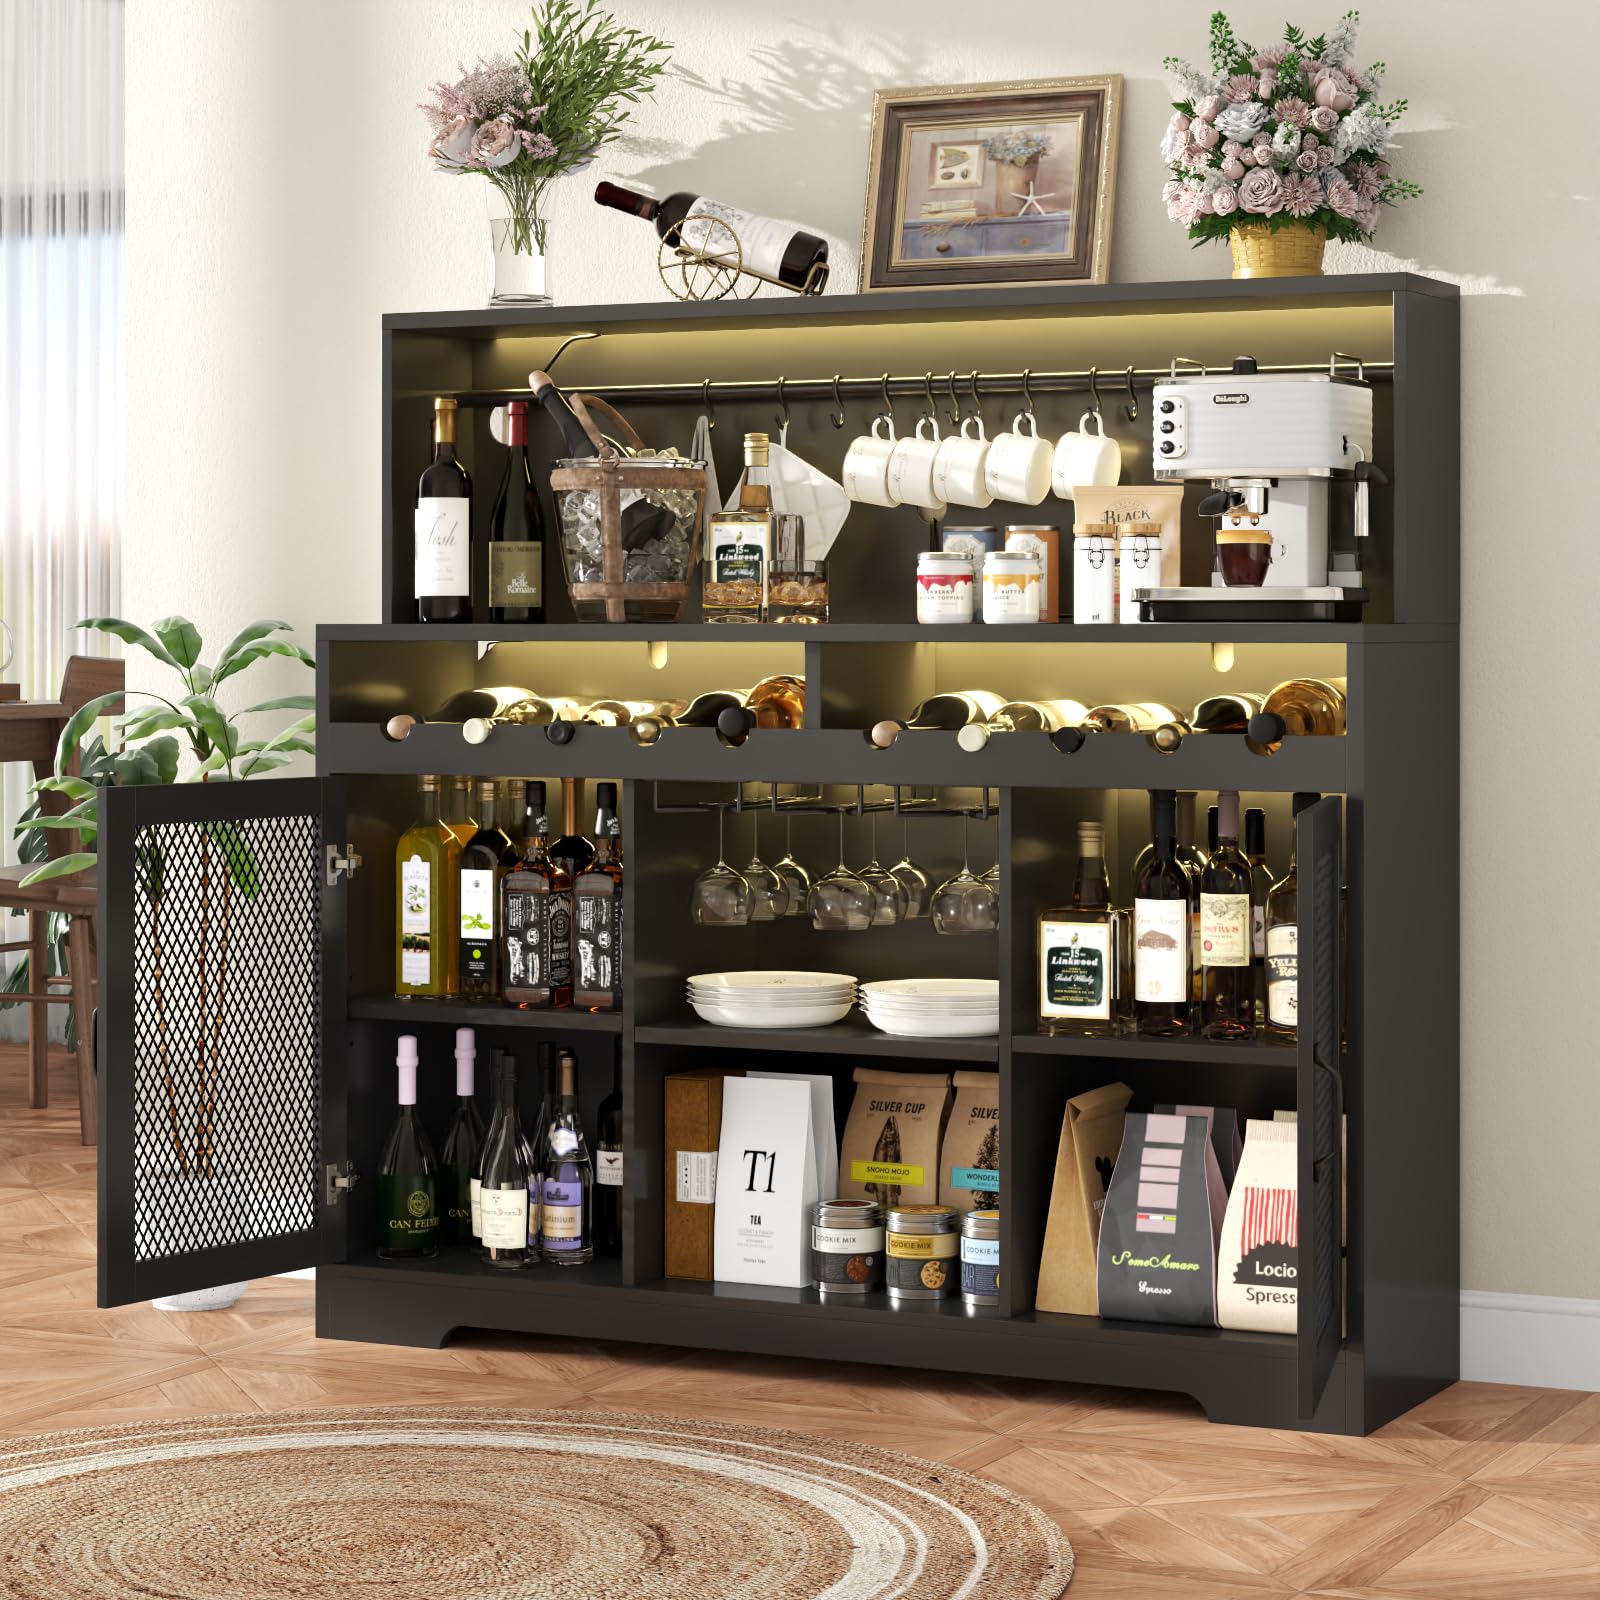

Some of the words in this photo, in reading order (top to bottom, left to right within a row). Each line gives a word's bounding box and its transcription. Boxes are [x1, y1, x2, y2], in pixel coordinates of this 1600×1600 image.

[1103, 509, 1151, 526] BLACK
[736, 545, 744, 554] 15
[719, 553, 759, 561] Linkwood
[1070, 948, 1080, 958] 15
[1051, 956, 1098, 966] Linkwood
[869, 1100, 903, 1113] SILVER
[904, 1102, 926, 1115] CUP
[970, 1107, 999, 1120] SILVE
[743, 1149, 776, 1193] T1
[866, 1166, 890, 1174] SNOHO
[891, 1168, 910, 1177] MOJO
[390, 1219, 411, 1229] CAN
[750, 1215, 762, 1225] TEA
[817, 1234, 841, 1243] COOKIE
[842, 1236, 857, 1244] MIX
[890, 1240, 915, 1249] COOKIE
[916, 1242, 932, 1250] MIX
[966, 1246, 991, 1255] COOKIE
[1255, 1260, 1297, 1279] Locio
